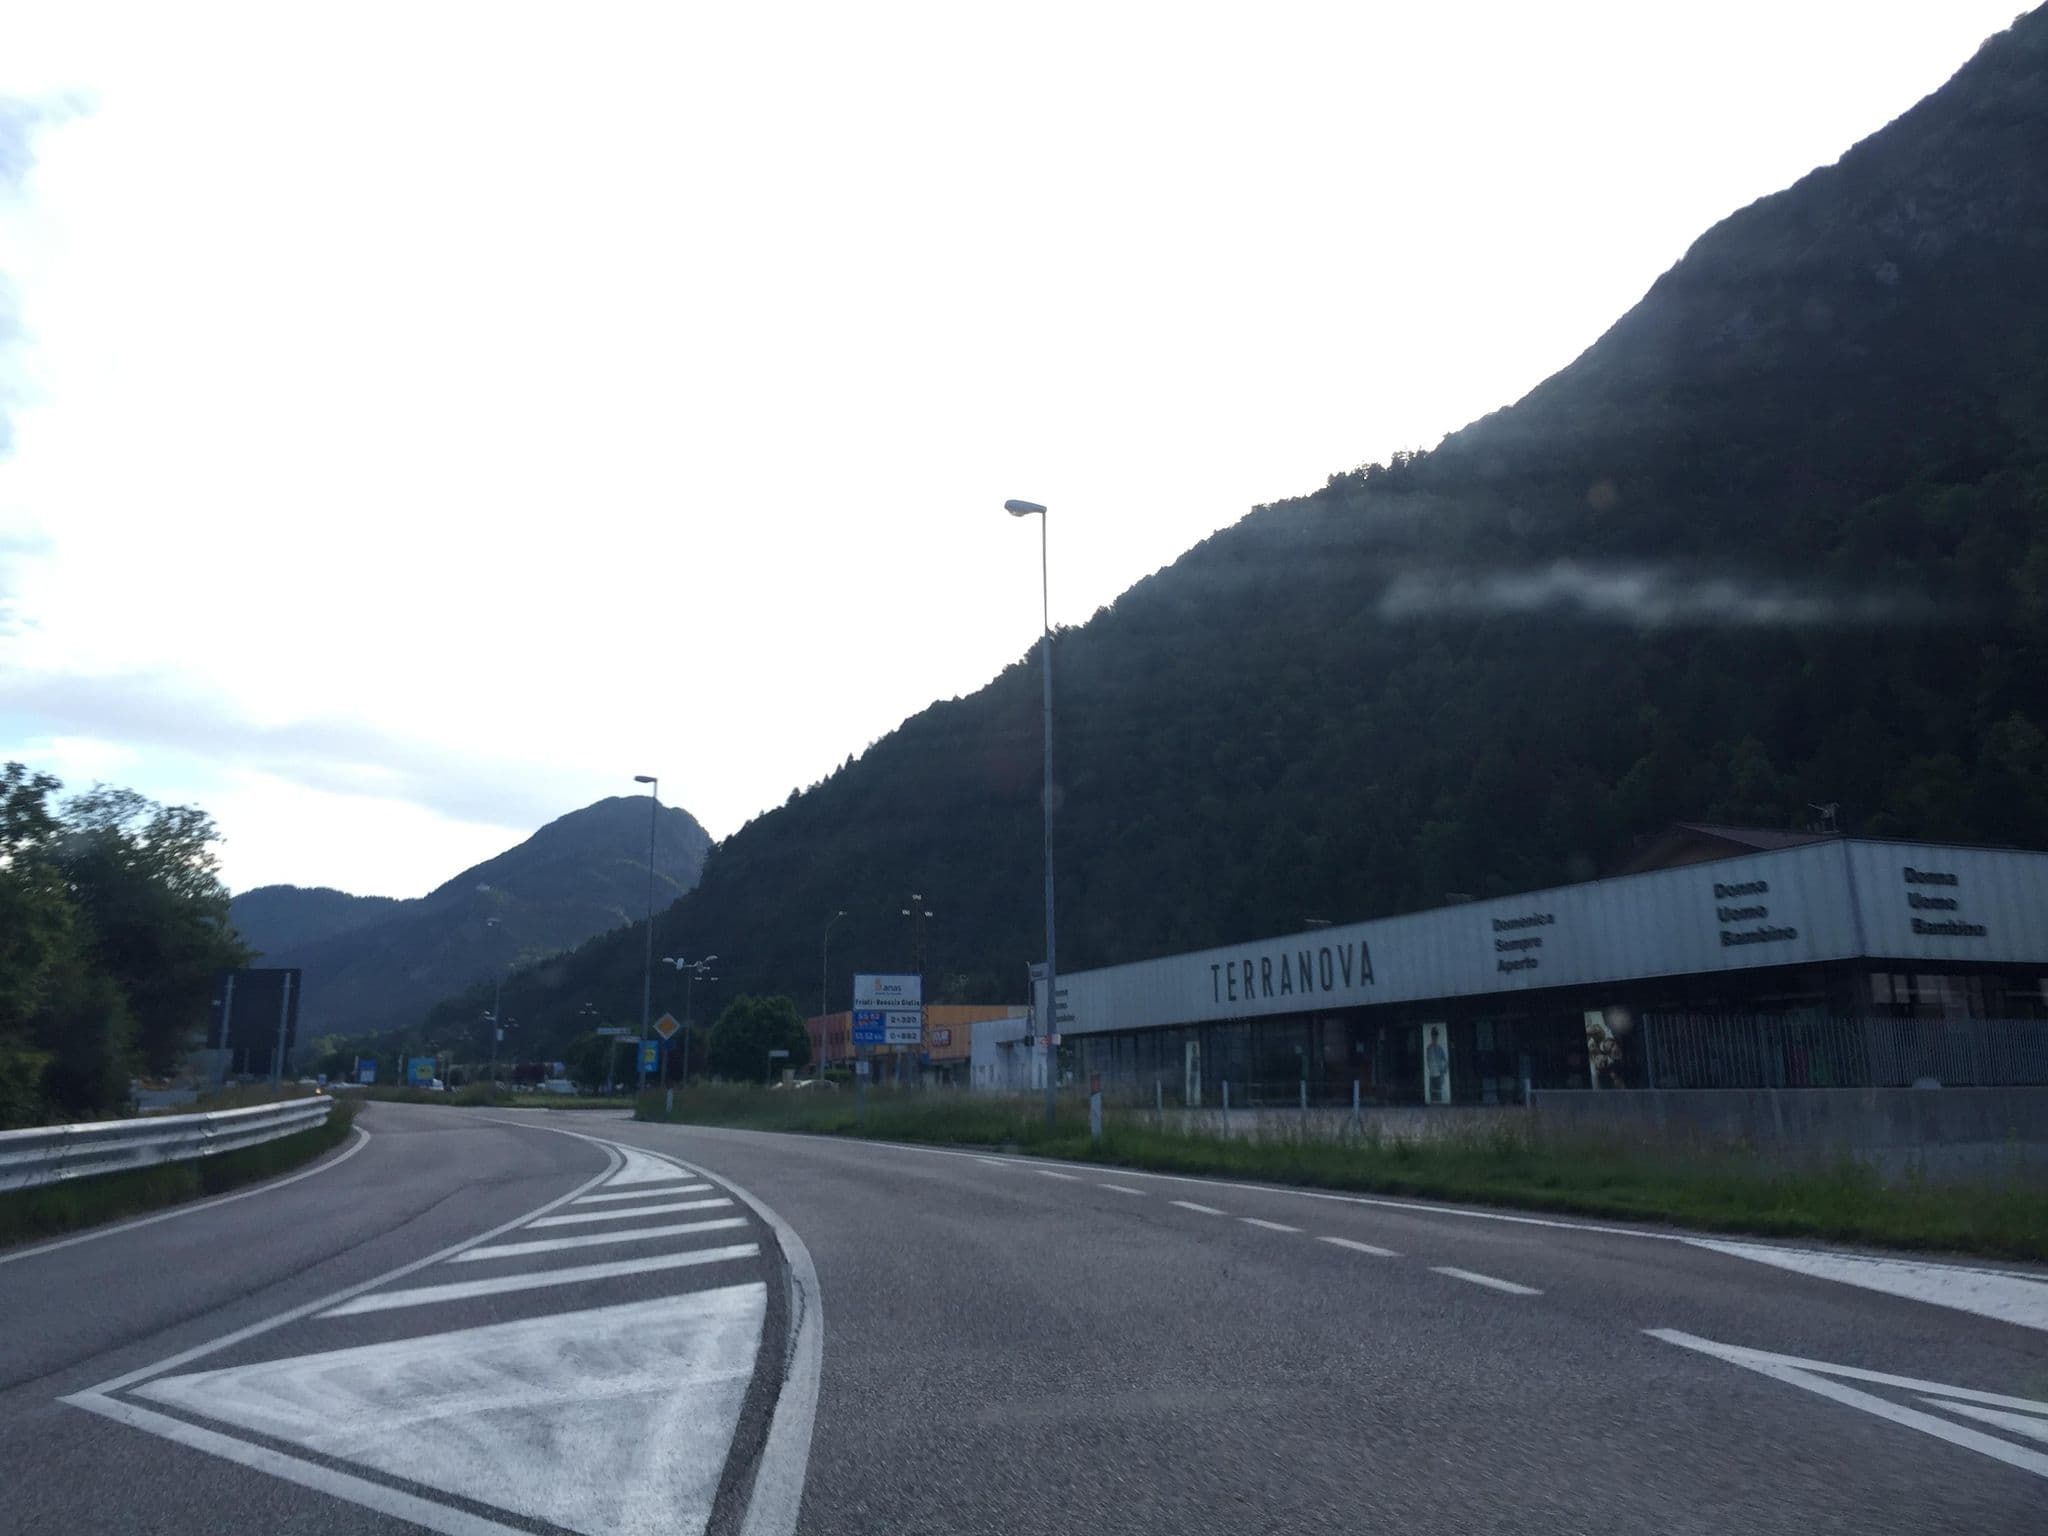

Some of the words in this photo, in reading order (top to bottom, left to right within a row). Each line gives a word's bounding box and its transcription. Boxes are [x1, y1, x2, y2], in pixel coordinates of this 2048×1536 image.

[1903, 867, 1958, 886] Donna
[1713, 881, 1769, 898] Donna
[1907, 892, 1958, 910] Uomo
[1717, 905, 1769, 922] Uomo
[1911, 917, 1987, 937] Bambino
[1495, 937, 1543, 953] Sempre
[1719, 926, 1798, 947] Bambino
[1210, 940, 1375, 1003] TERRANOVA
